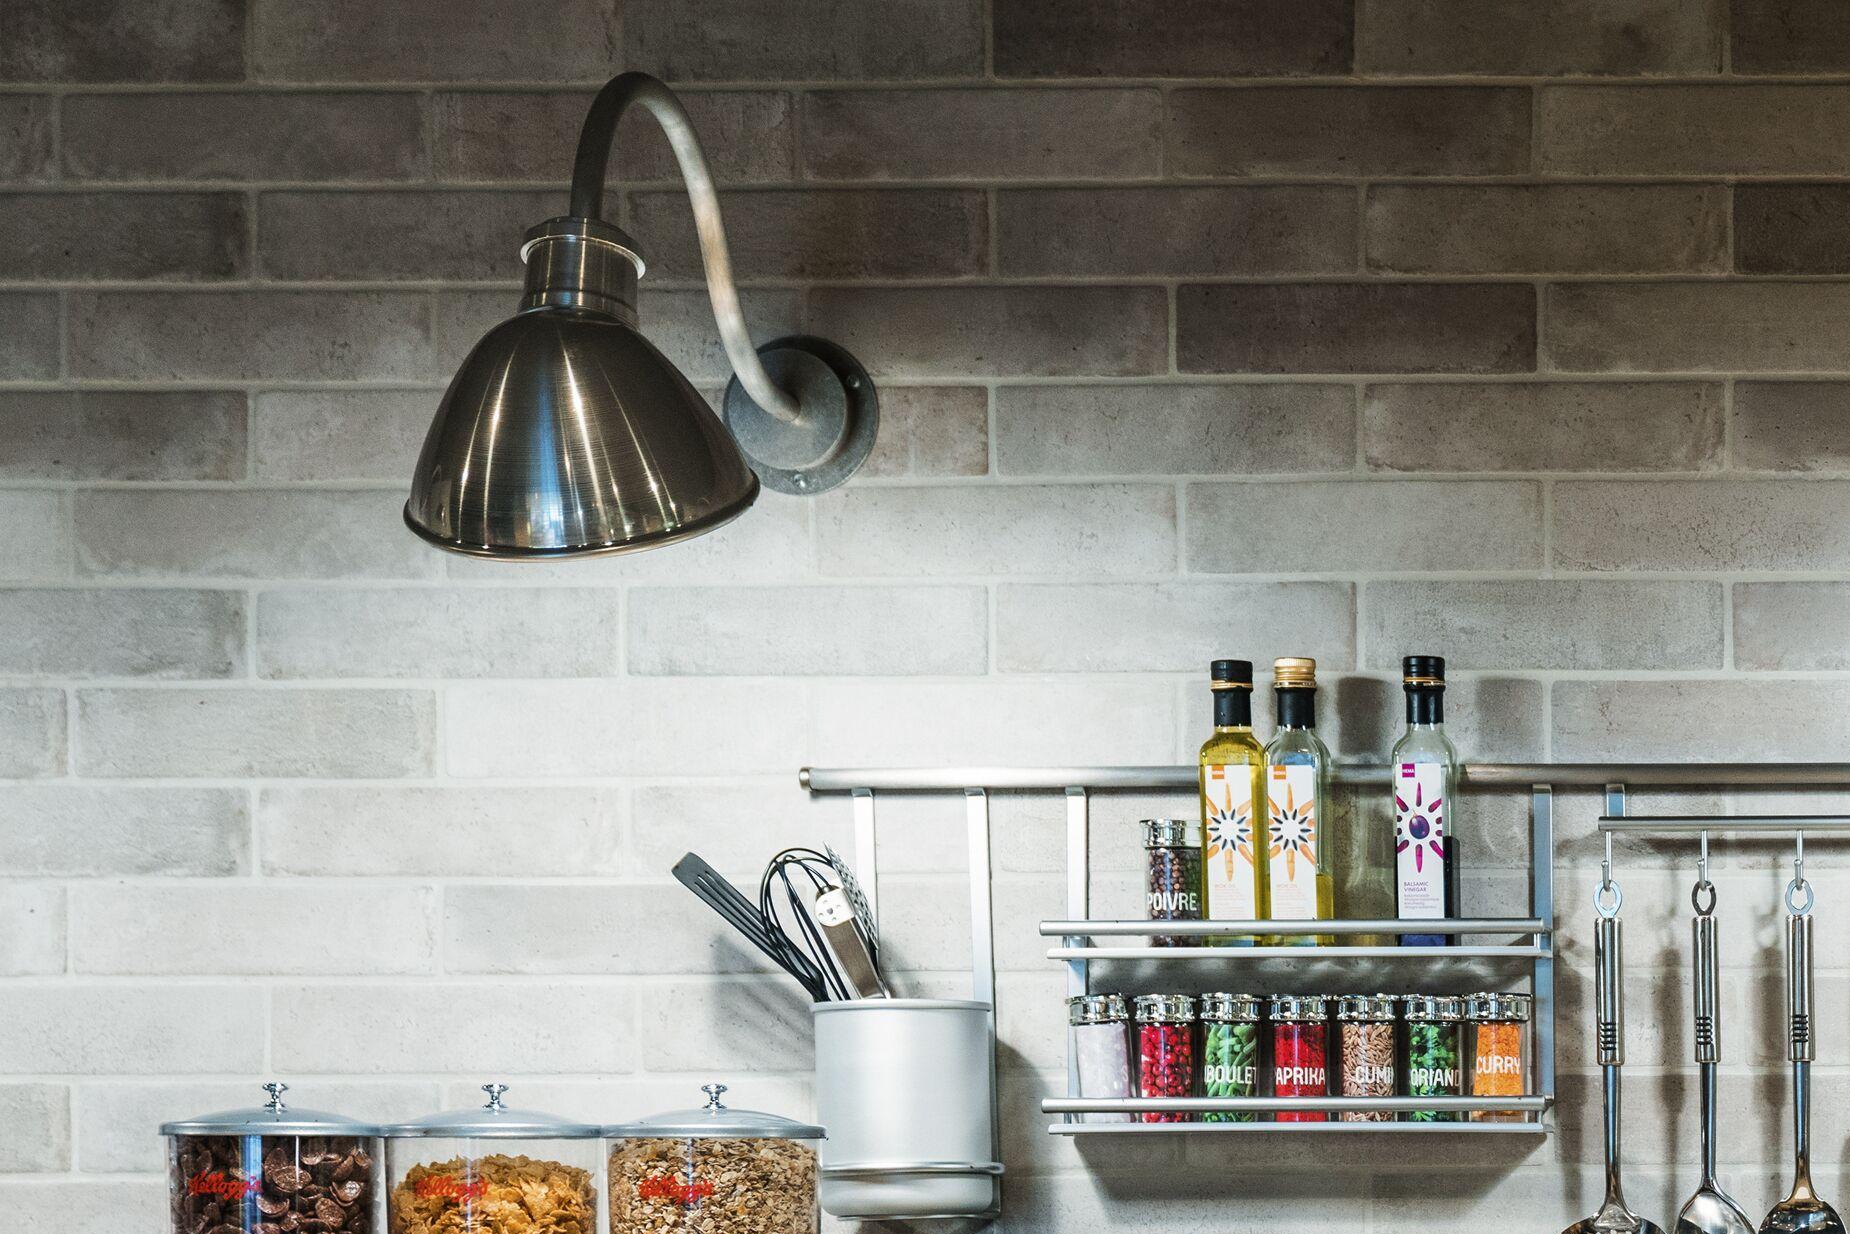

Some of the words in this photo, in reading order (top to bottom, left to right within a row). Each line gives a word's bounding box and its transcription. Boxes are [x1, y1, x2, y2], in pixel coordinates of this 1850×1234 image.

[1146, 892, 1198, 911] POIVRE
[1476, 1056, 1520, 1075] CURRY
[188, 1169, 264, 1200] Kellogg's
